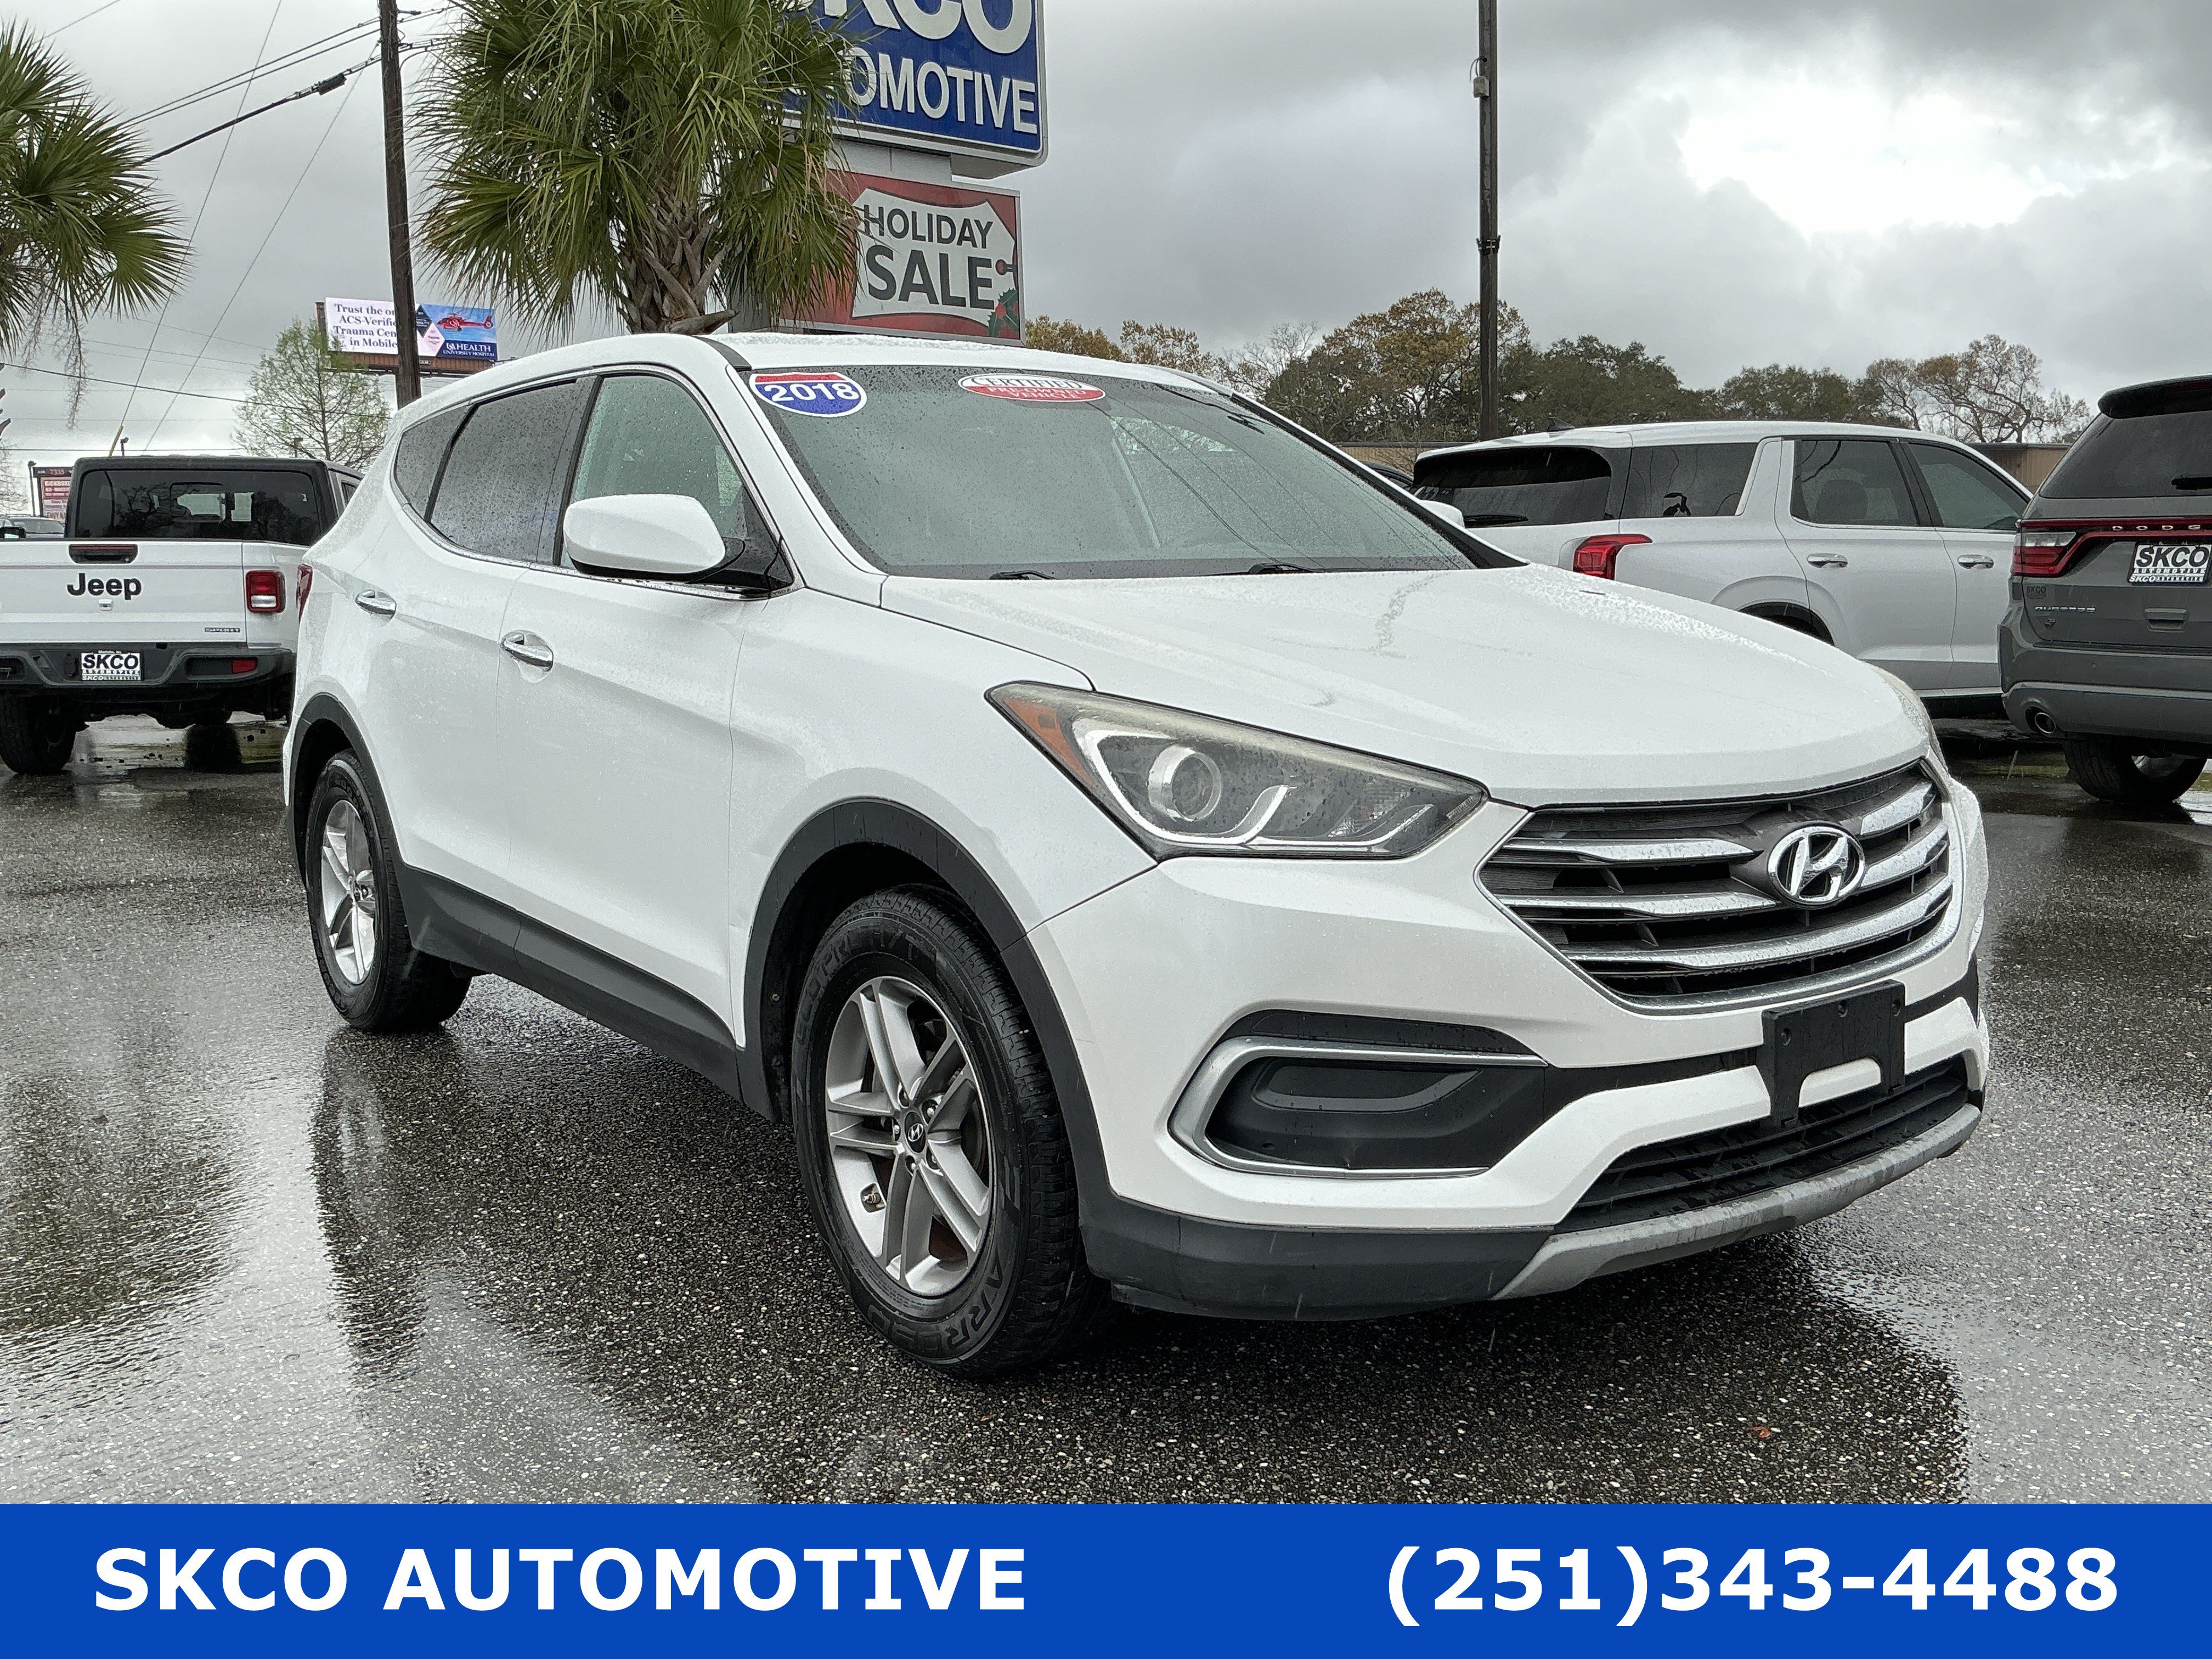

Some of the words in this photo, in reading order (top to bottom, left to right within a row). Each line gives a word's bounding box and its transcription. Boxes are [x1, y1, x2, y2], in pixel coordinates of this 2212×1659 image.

[790, 46, 1038, 134] OMOTIVE
[863, 204, 994, 250] HOLIDAY
[866, 244, 995, 311] SALE
[334, 303, 363, 314] Trust
[366, 305, 383, 314] the
[333, 325, 375, 336] Trauma
[349, 337, 360, 346] in
[970, 377, 1083, 389] CERTIFIED
[764, 382, 860, 402] 2018
[987, 387, 1087, 396] PRE-OWNED
[1008, 391, 1082, 399] VEHICLE
[2136, 546, 2210, 568] SKCO
[66, 572, 142, 601] Jeep
[82, 654, 139, 669] SKCO
